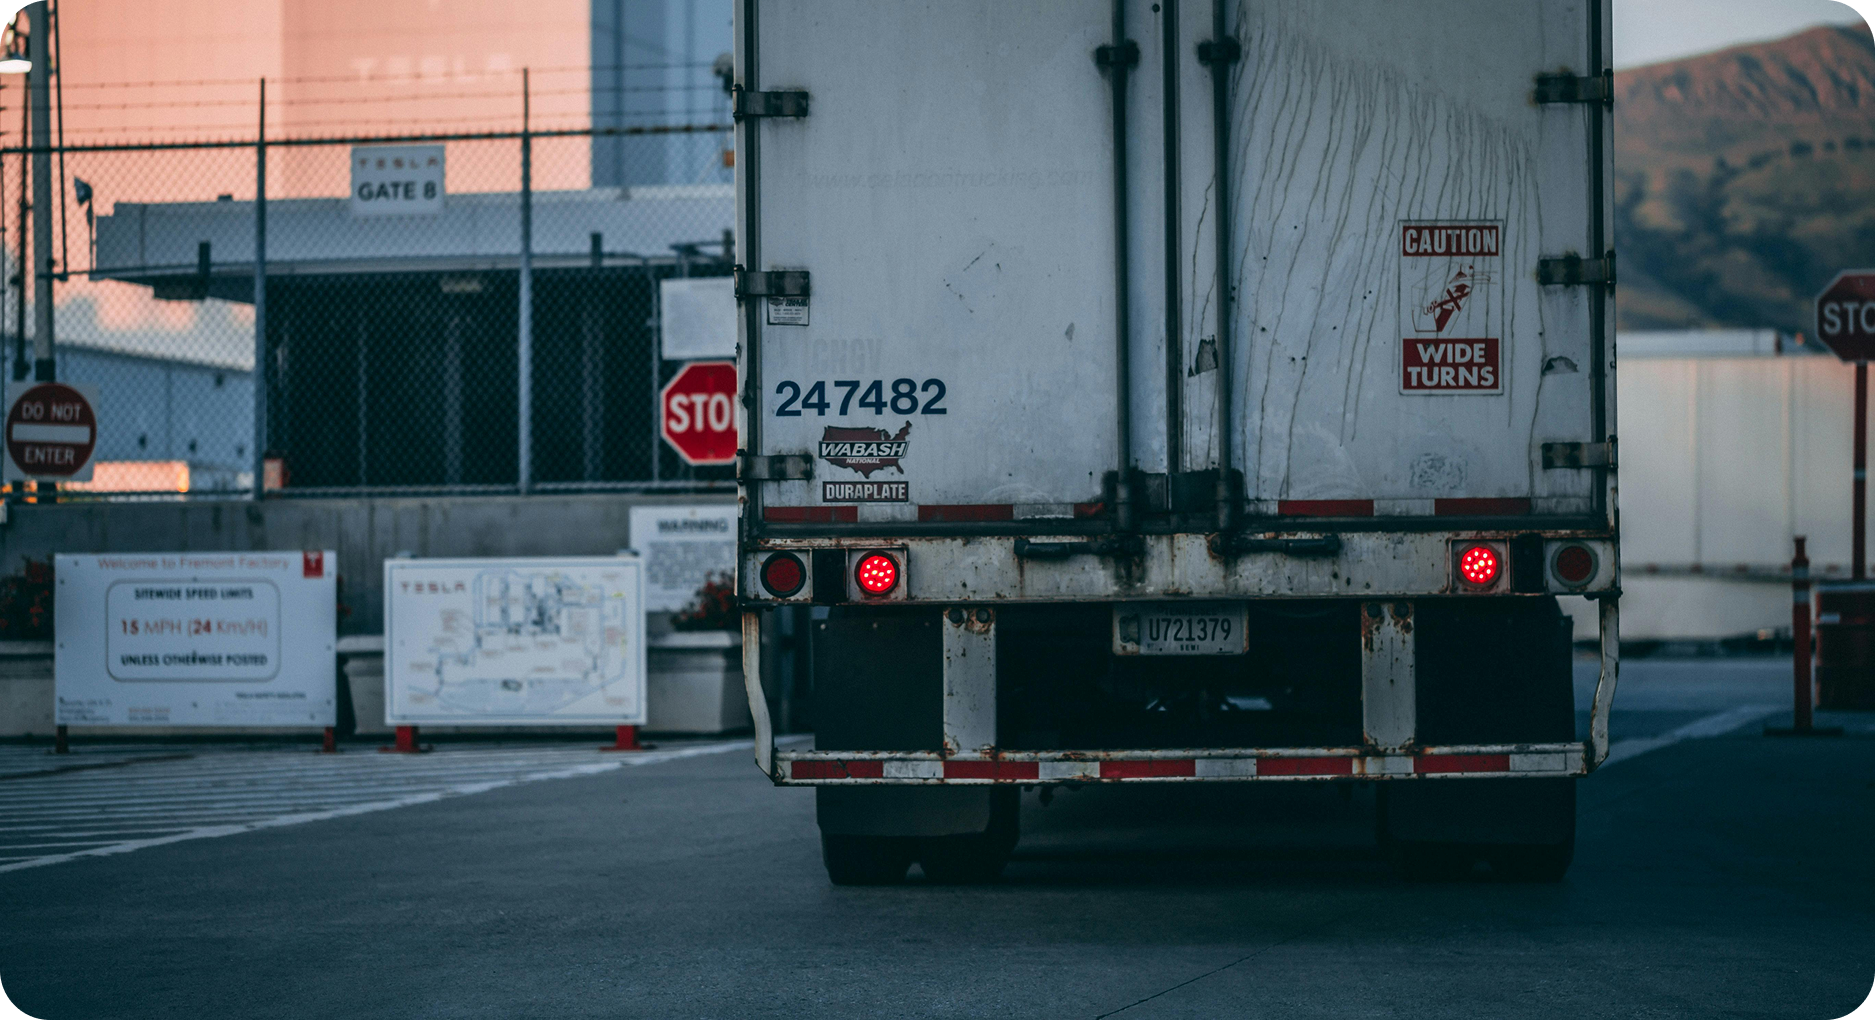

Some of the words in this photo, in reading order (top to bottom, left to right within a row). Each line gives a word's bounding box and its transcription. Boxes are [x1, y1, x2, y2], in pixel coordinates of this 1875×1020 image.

[359, 157, 439, 169] TESLA
[357, 181, 416, 201] GATE
[423, 180, 437, 199] 8
[1405, 229, 1497, 253] CAUTION
[1416, 343, 1486, 364] WIDE
[1407, 366, 1495, 387] TURNS
[775, 378, 948, 417] 247482
[22, 401, 44, 420] DO
[50, 402, 82, 421] NOT
[668, 392, 738, 433] STO
[24, 446, 76, 465] ENTER
[821, 443, 907, 456] WABASH
[825, 483, 906, 500] DURAPLATE
[657, 517, 729, 533] WARNING
[97, 557, 157, 570] Welcome
[162, 558, 176, 569] to
[180, 558, 236, 570] Fremont
[239, 558, 290, 571] Factory
[135, 587, 182, 600] SITEWIDE
[185, 587, 218, 600] SPEED
[220, 587, 254, 600] LIMITS
[401, 581, 466, 593] TESLA
[121, 619, 139, 635] 15
[144, 619, 182, 635] MPH
[1149, 617, 1232, 641] U721379
[121, 654, 160, 667] UNLESS
[163, 654, 223, 667] OTHERWISE
[226, 654, 268, 667] POSTED
